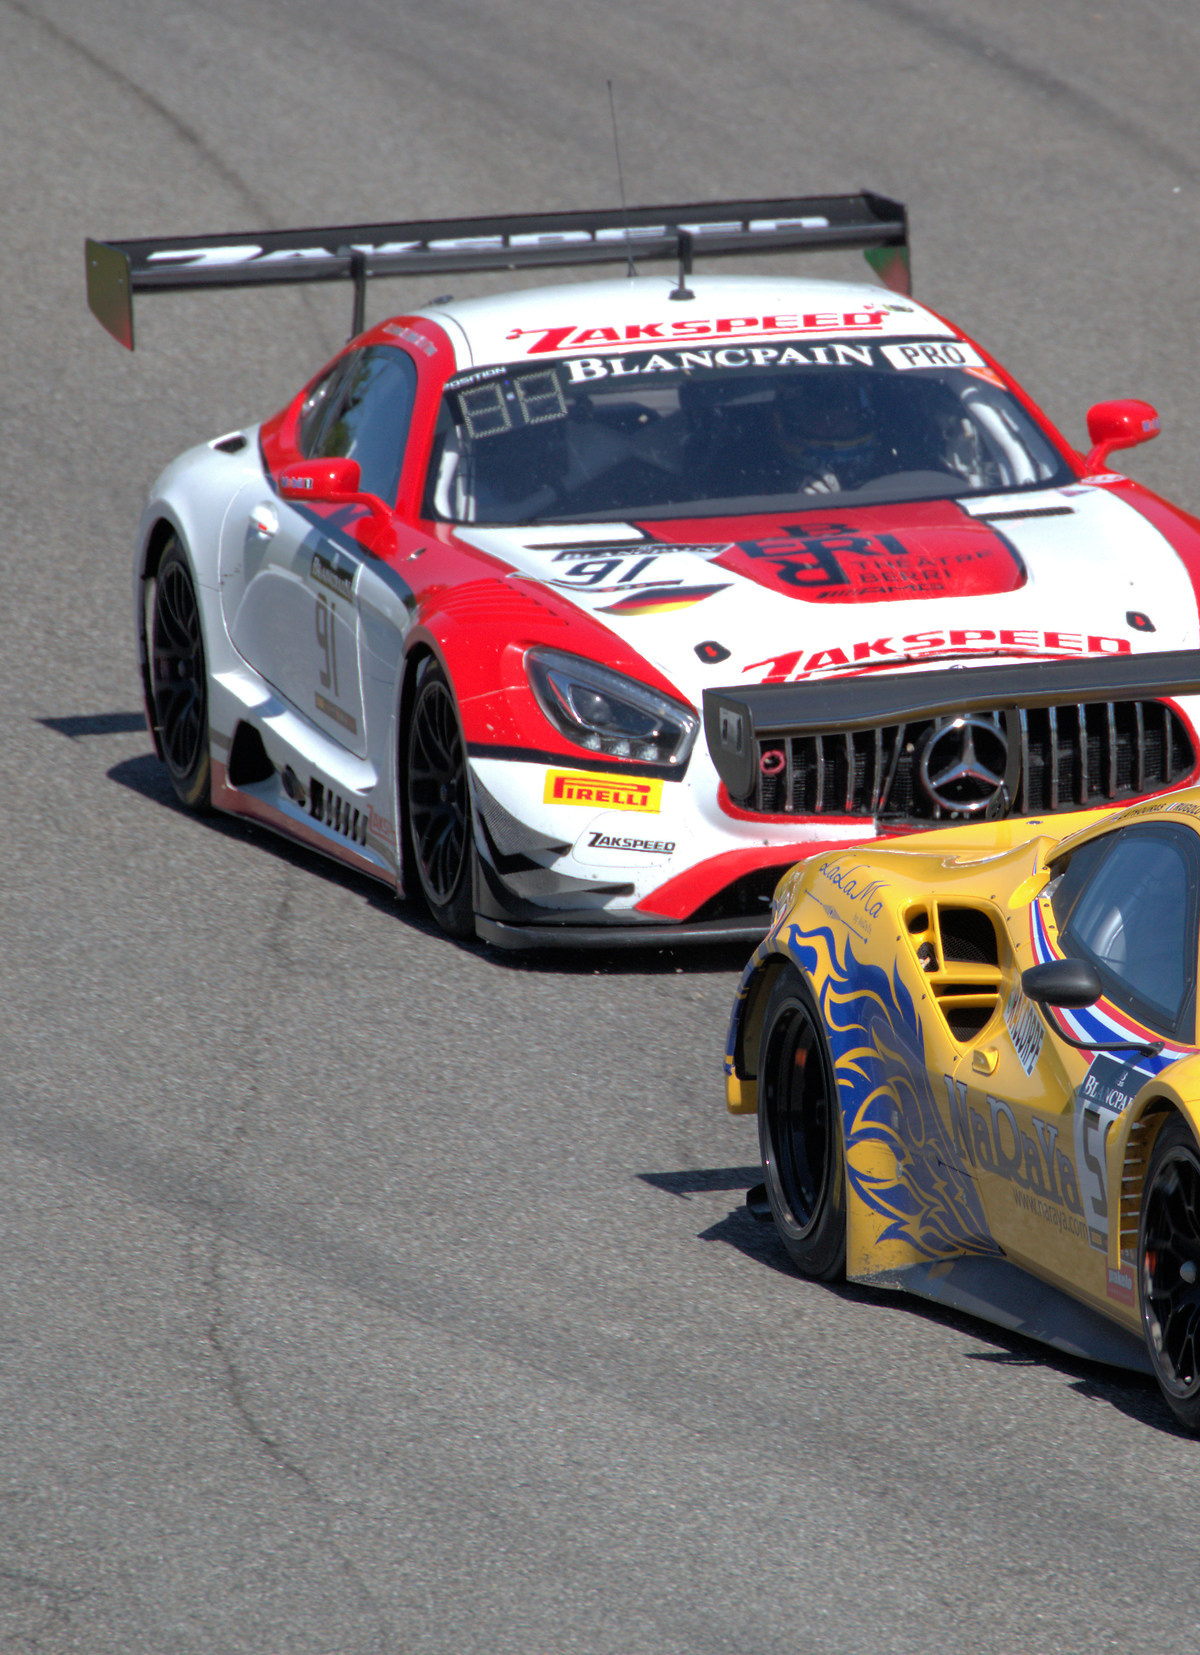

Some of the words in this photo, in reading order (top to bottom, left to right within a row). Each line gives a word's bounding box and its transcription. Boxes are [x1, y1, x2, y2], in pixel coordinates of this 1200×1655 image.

[506, 303, 888, 354] ZAKSPEED
[563, 344, 874, 384] BLANCPAIN
[898, 344, 966, 365] PRO
[564, 556, 660, 586] 91
[315, 592, 339, 697] 91
[741, 629, 1132, 684] ZAKSPEED
[553, 776, 651, 806] PIRELLI
[587, 831, 676, 854] ZAKSPEED
[1082, 1107, 1115, 1219] 5
